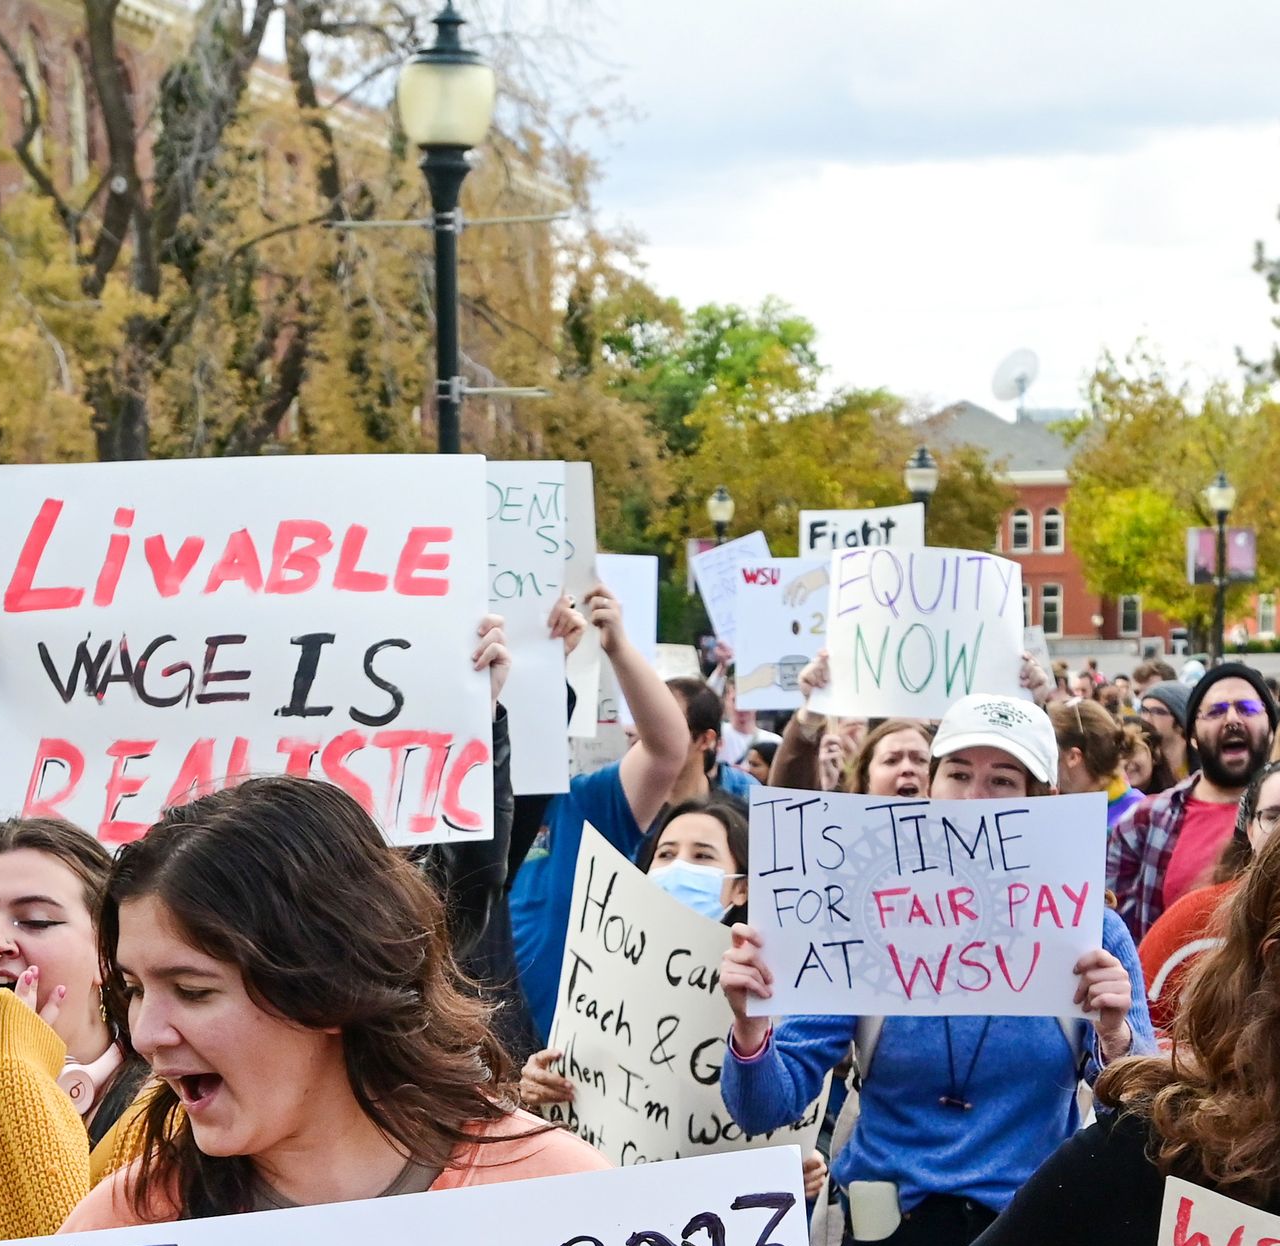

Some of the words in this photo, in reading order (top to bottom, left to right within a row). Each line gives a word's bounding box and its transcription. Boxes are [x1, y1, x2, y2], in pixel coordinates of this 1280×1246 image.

[486, 480, 565, 526] DENT
[742, 567, 781, 586] WSU
[837, 549, 1013, 620] EQUITY
[37, 631, 252, 711] WAGE
[274, 632, 413, 728] IS
[855, 621, 985, 698] NOW
[865, 800, 1031, 878] TIME
[579, 855, 647, 965] How
[772, 885, 852, 928] FOR
[872, 885, 980, 928] FAIR
[1008, 881, 1090, 929] PAY
[567, 950, 632, 1047] Teach
[794, 939, 865, 990] AT
[887, 940, 1042, 1001] WSU
